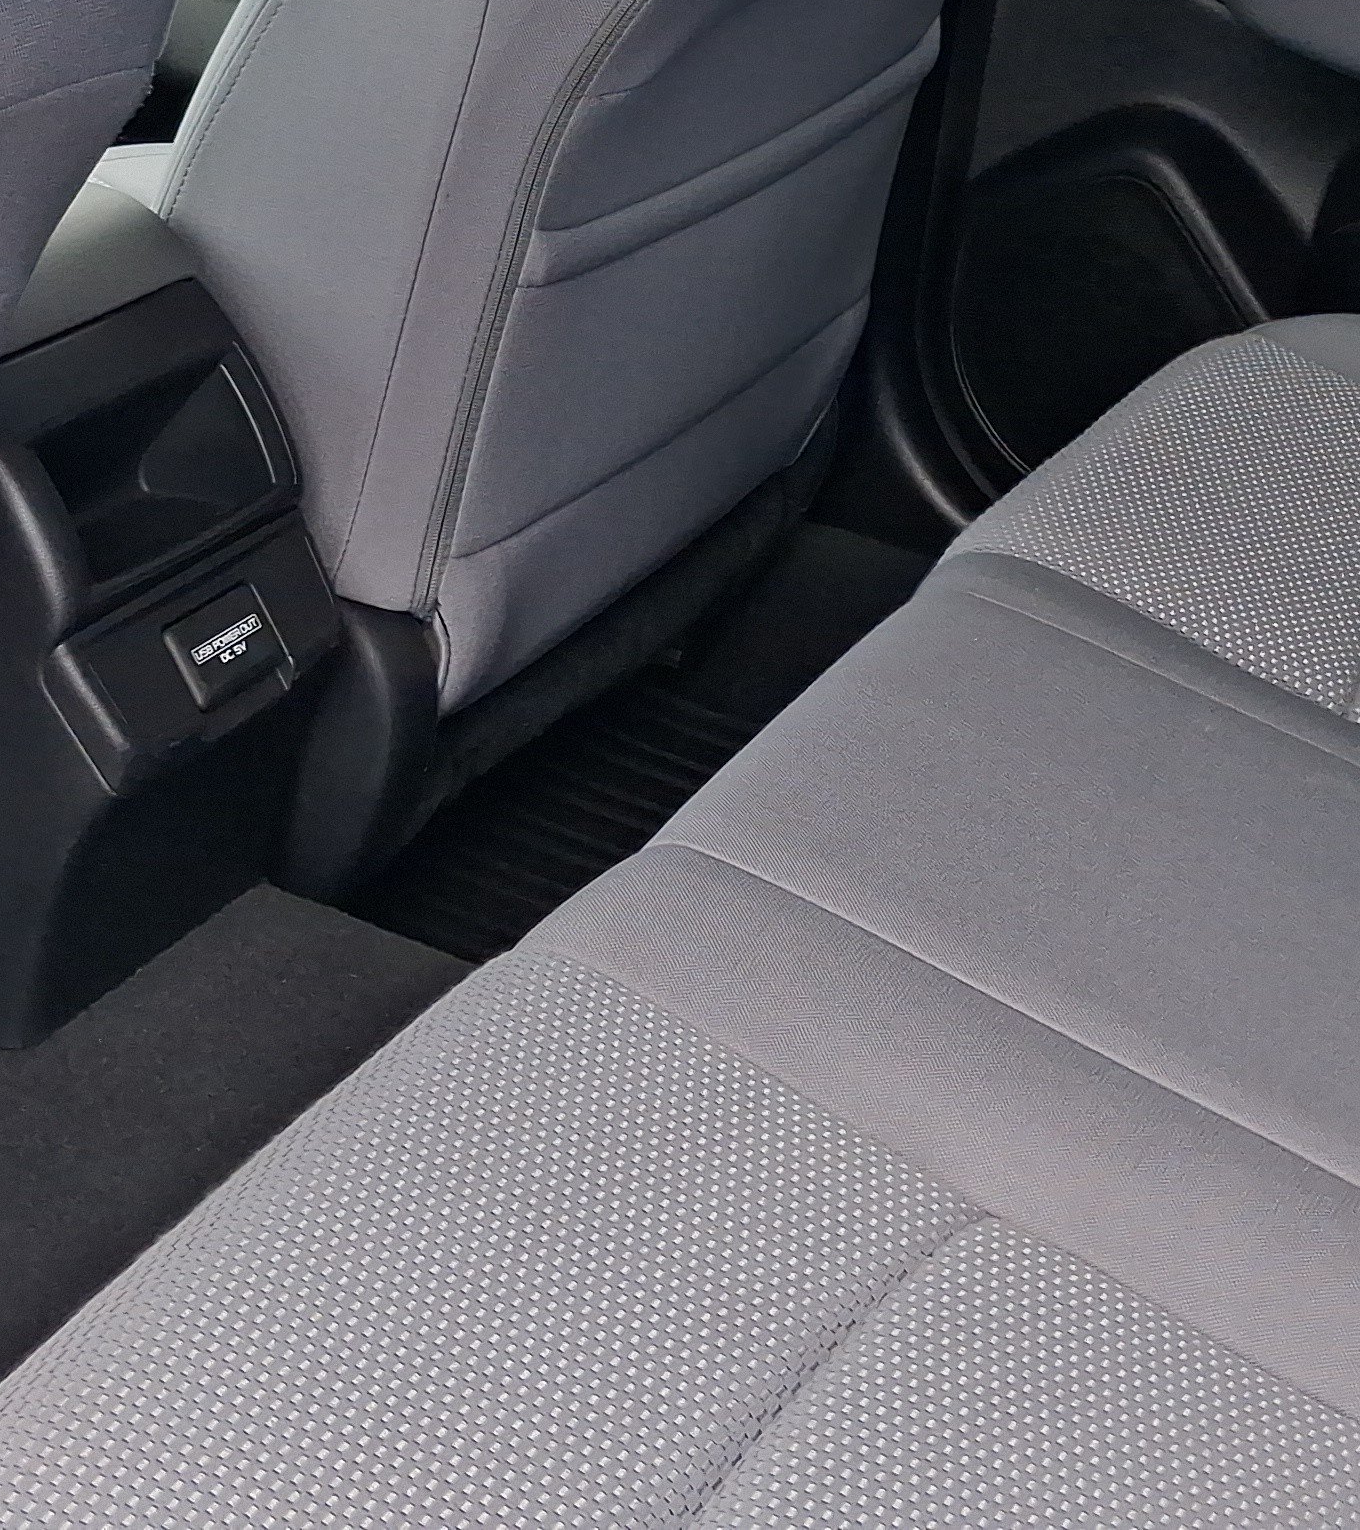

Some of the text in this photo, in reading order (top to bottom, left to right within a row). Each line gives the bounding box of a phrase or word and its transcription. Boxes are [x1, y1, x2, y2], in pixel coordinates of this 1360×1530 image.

[194, 617, 258, 661] USB POWER OUT
[220, 640, 248, 664] DC 5V
